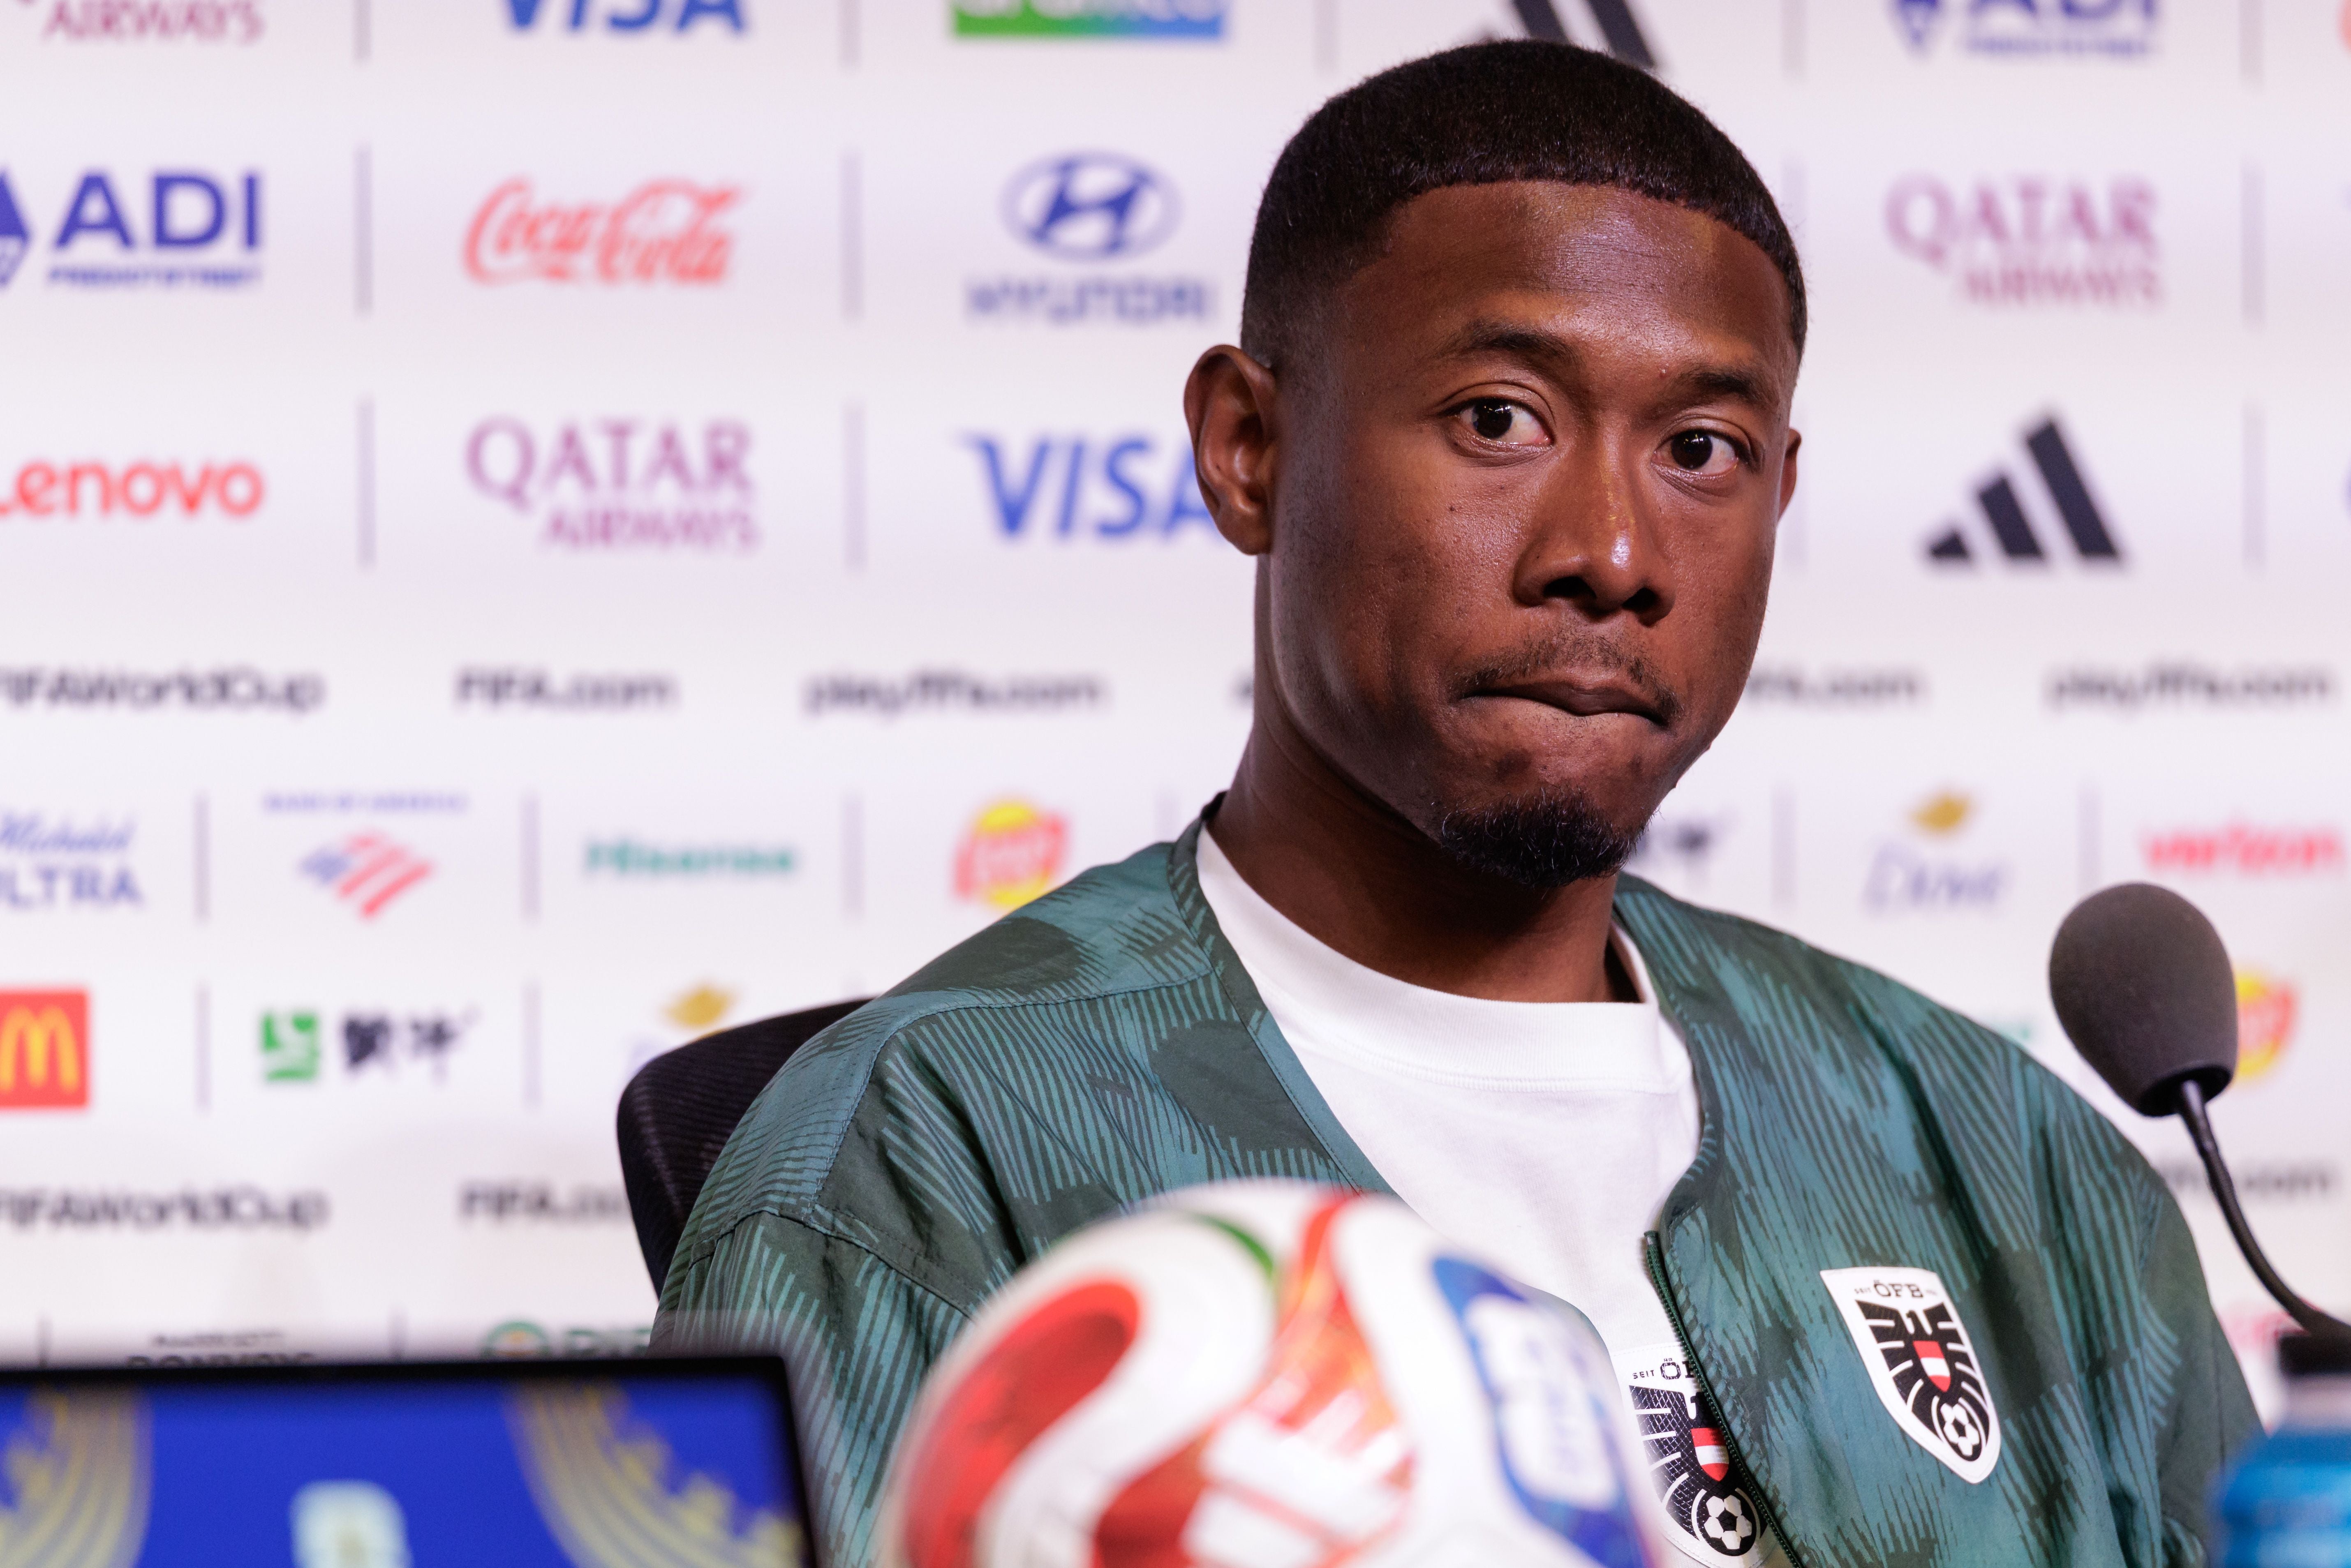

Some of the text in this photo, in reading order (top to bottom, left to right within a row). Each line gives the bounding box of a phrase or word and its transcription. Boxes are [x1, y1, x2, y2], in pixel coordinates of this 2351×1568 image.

[54, 171, 261, 251] ADI
[0, 458, 265, 519] enovo
[464, 415, 756, 510] QATAR
[1874, 1279, 1923, 1298] ÖFB
[1632, 1370, 1654, 1379] SEIT
